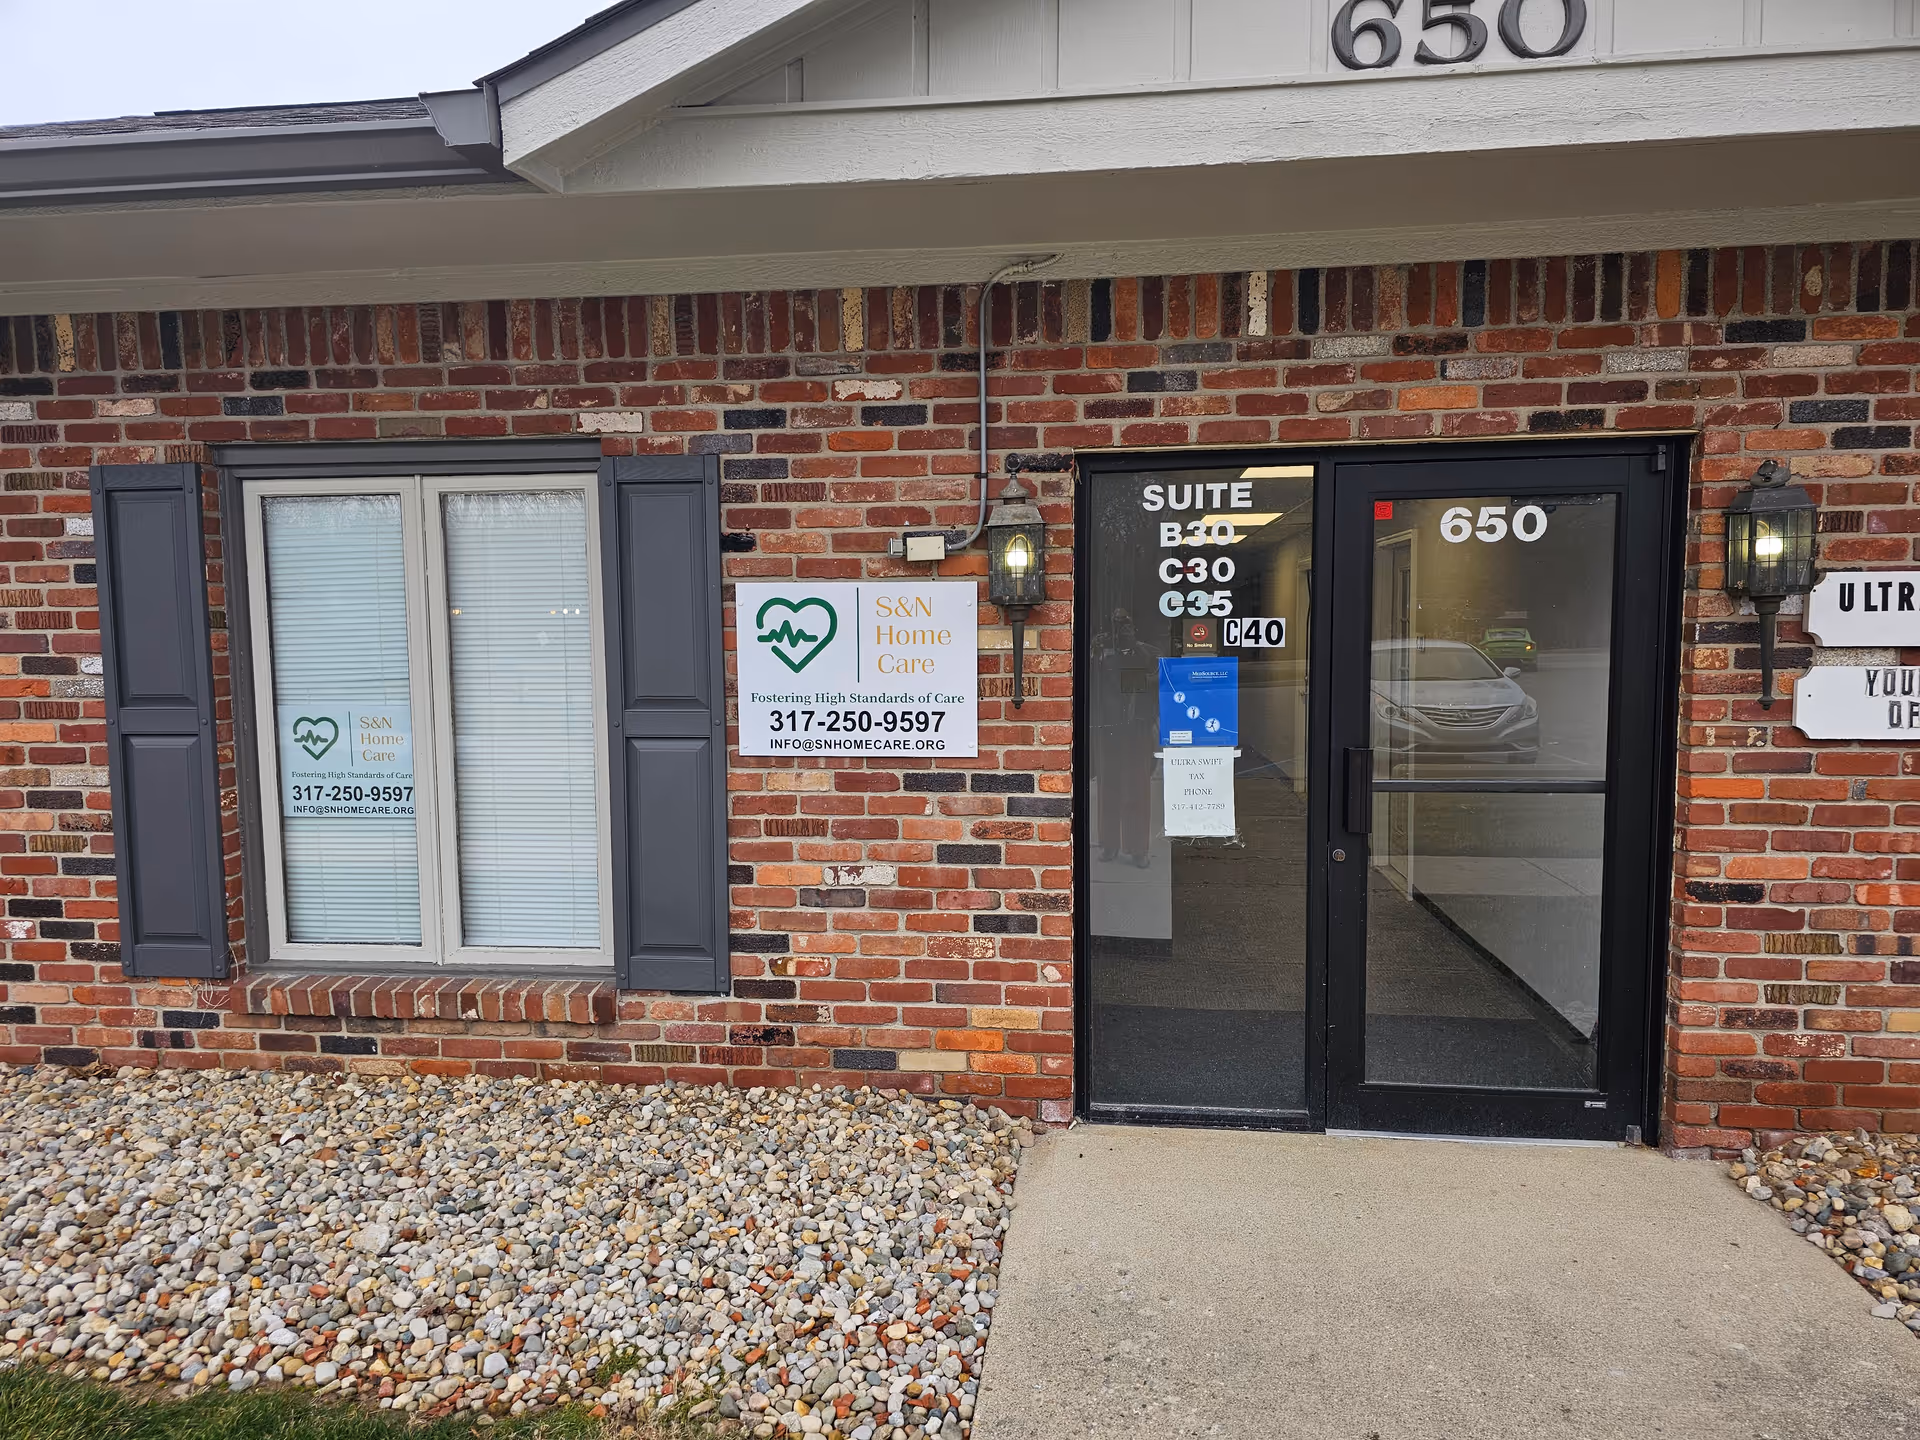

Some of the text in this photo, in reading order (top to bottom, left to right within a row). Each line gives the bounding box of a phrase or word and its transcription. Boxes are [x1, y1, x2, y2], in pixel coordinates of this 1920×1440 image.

[1331, 0, 1588, 70] 650
[1142, 481, 1253, 512] SUITE
[1160, 520, 1235, 547] B30
[1440, 505, 1548, 543] 650
[1158, 556, 1236, 584] C30
[876, 596, 933, 618] S&N
[1158, 590, 1234, 618] C35
[1839, 581, 1920, 612] ULTR
[876, 625, 952, 646] Home
[1225, 619, 1284, 645] C40
[877, 653, 935, 675] Care
[1865, 668, 1920, 698] YOU
[751, 692, 965, 706] Fostering High Standards of Care
[359, 716, 392, 729] S&N
[769, 710, 946, 733] 317-250-9597
[360, 733, 404, 745] Home
[770, 739, 946, 752] INFO@SNHOMECARE.ORG
[362, 749, 396, 762] Care
[1171, 758, 1223, 766] ULTRA SWIFT
[291, 771, 327, 780] Fostering
[328, 771, 346, 779] High
[347, 771, 385, 779] Standards
[386, 771, 394, 779] of
[292, 785, 414, 802] 317-250-9597
[1184, 788, 1213, 796] PHONE
[293, 805, 415, 815] INFO@SNHOMECARE.ORG
